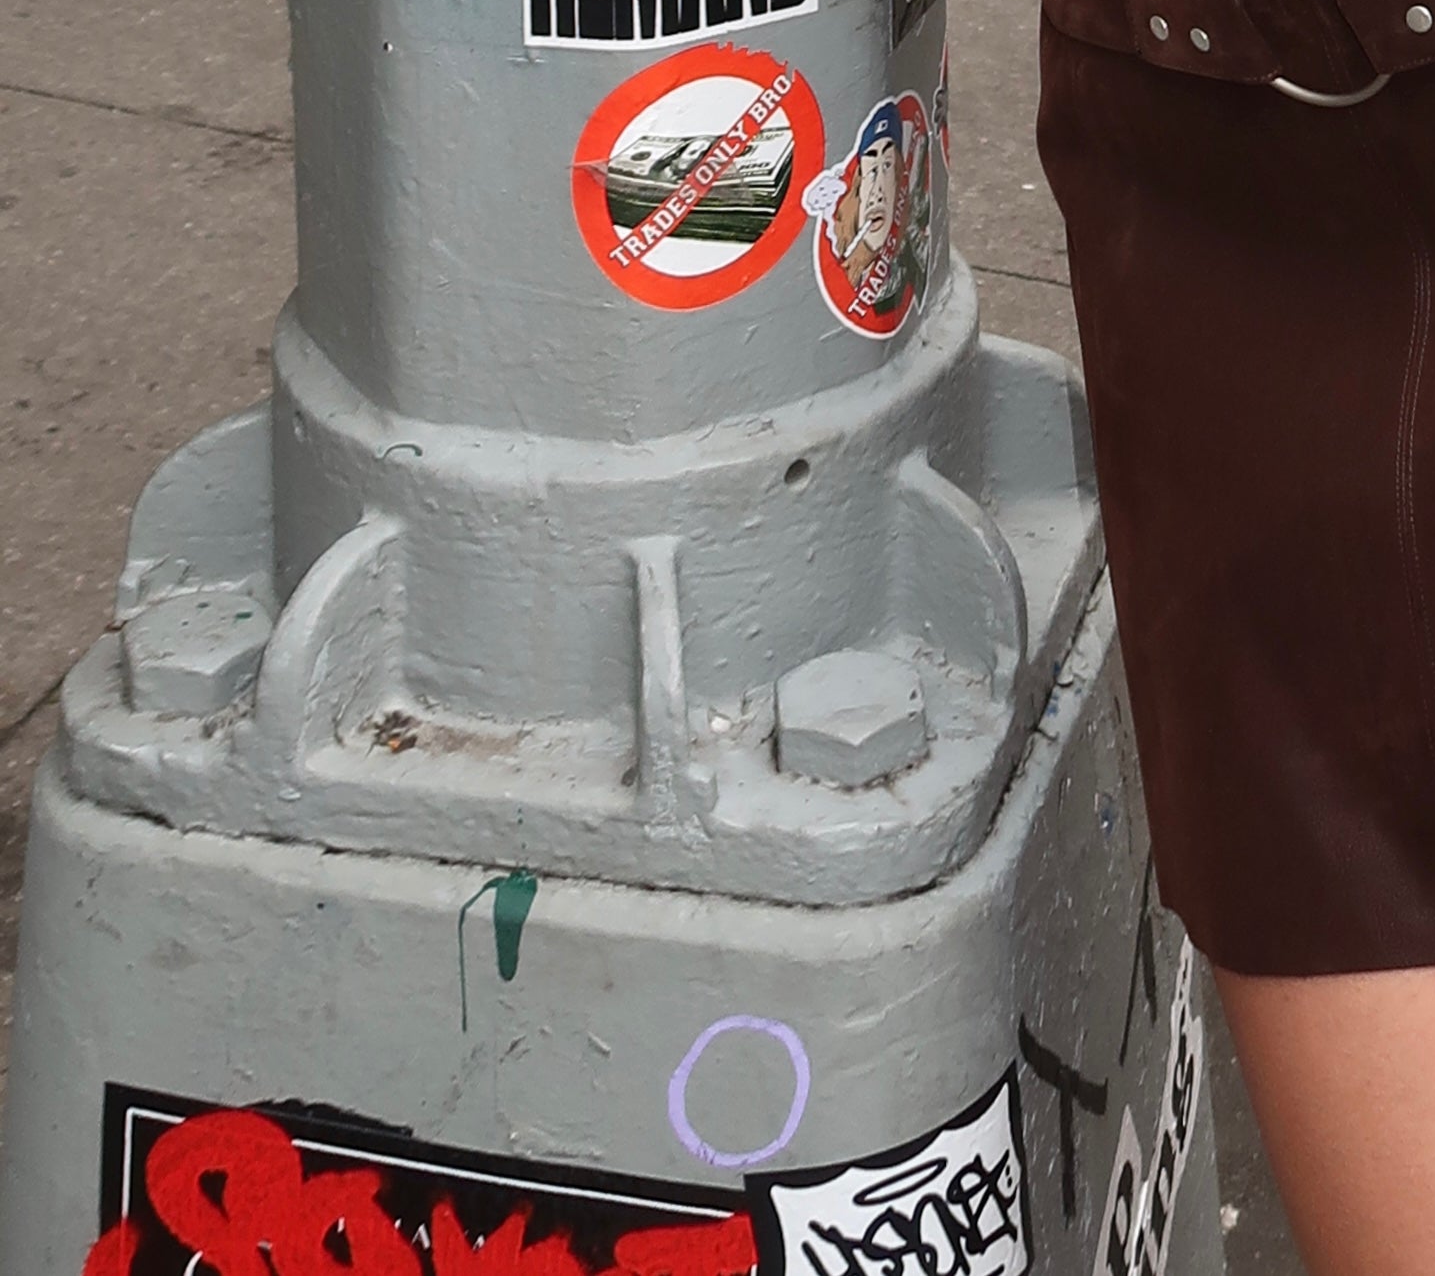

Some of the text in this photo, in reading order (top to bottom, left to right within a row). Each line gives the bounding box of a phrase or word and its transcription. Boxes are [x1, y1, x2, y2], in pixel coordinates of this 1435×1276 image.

[609, 74, 793, 268] TRADES ONLY BRO
[848, 235, 898, 317] TRADES
